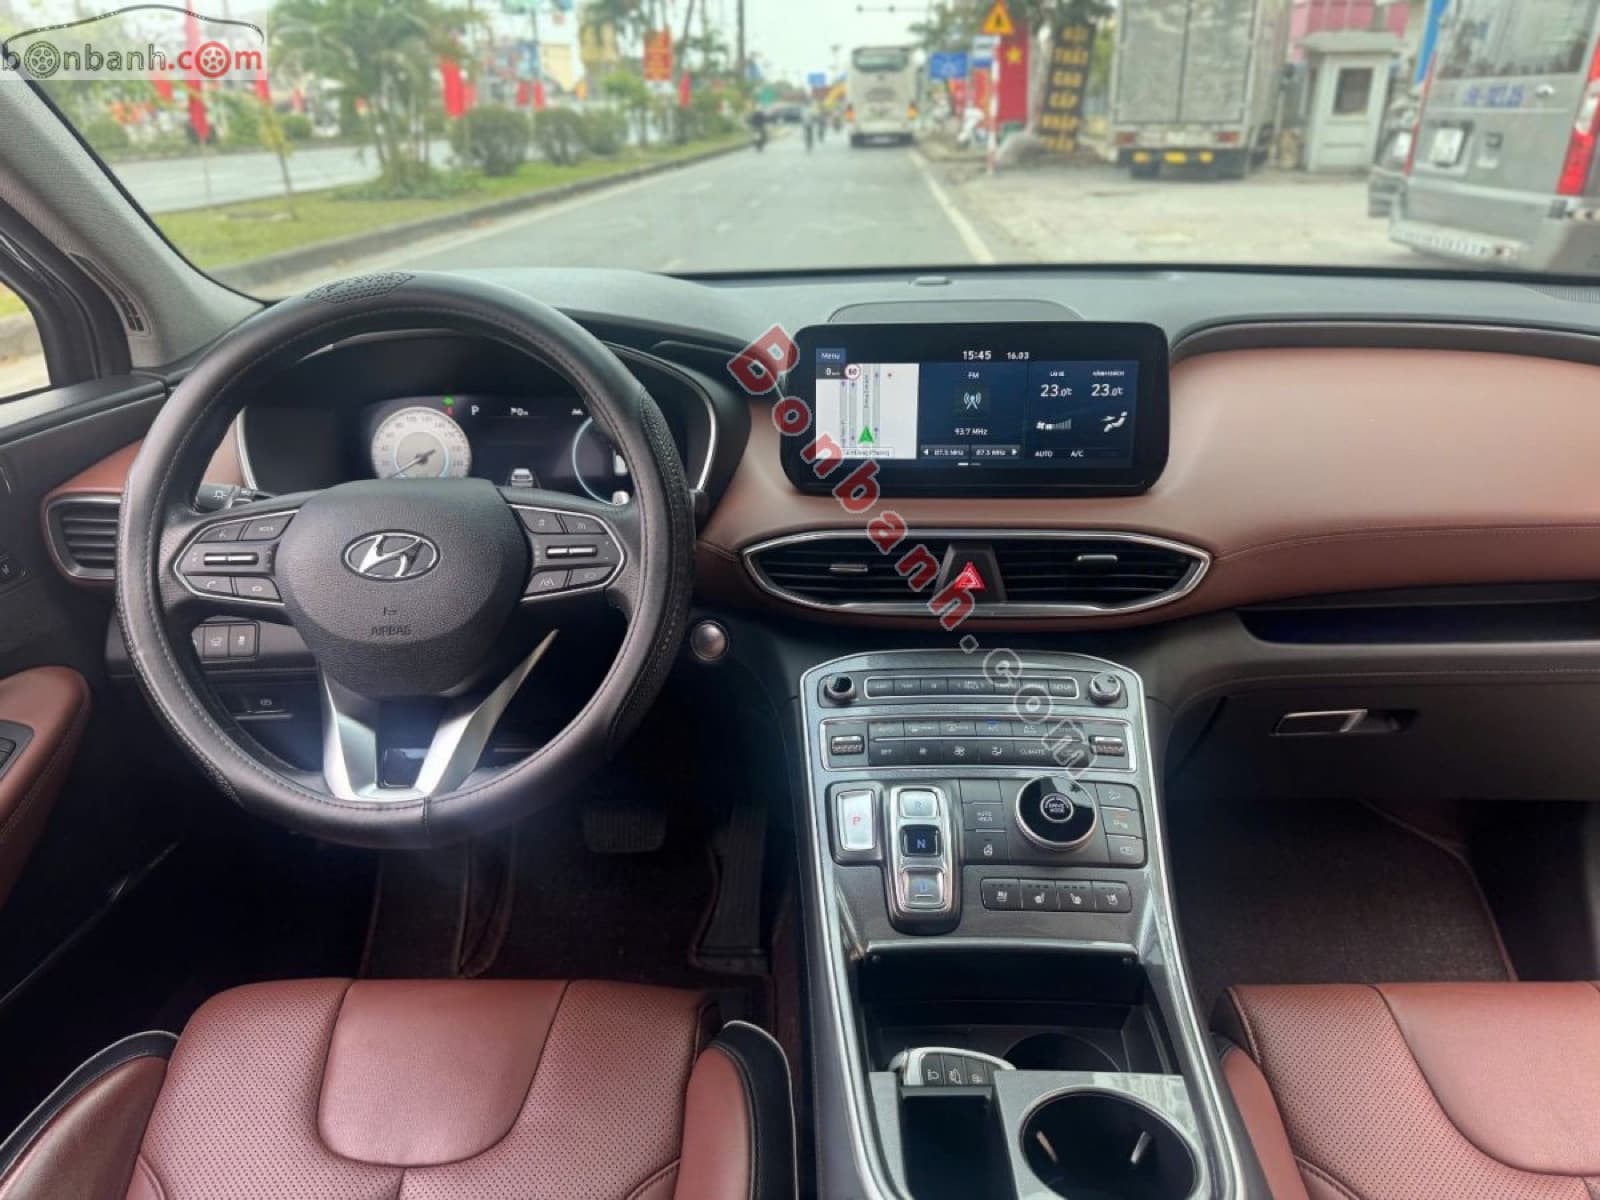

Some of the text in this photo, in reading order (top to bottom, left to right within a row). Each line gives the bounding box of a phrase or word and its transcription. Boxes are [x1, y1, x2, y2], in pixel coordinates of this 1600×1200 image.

[962, 350, 1030, 360] 15:45 16.03
[968, 371, 980, 379] FM
[471, 406, 480, 416] P
[1034, 449, 1085, 458] AUTO A/C
[371, 624, 411, 636] AIRBAG
[852, 815, 862, 827] P
[916, 839, 927, 849] N
